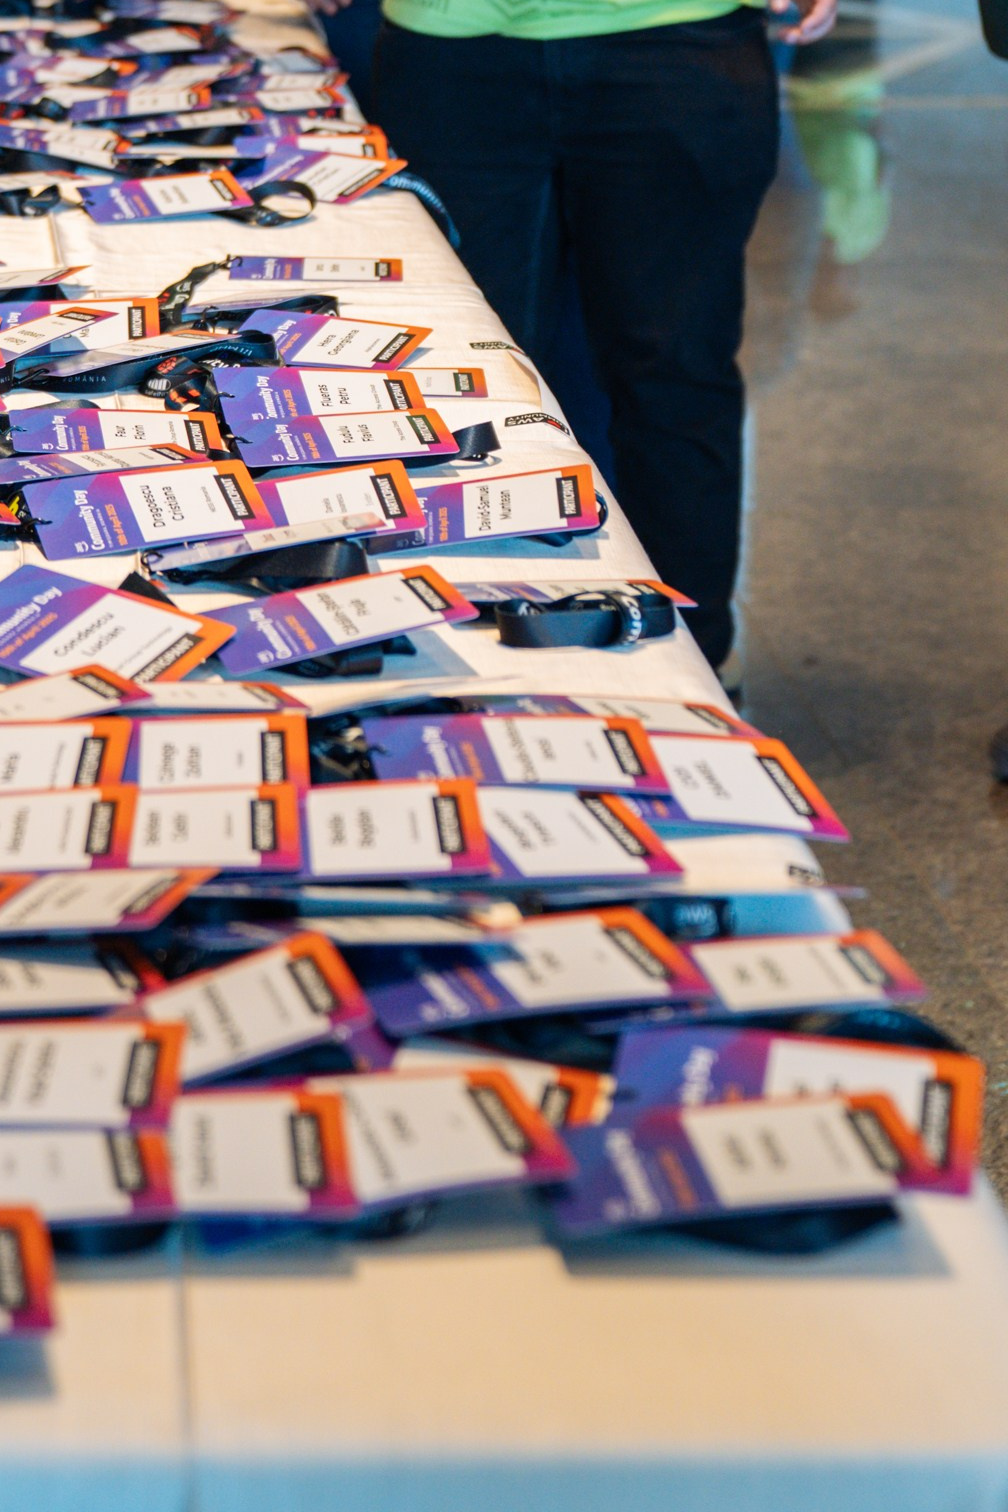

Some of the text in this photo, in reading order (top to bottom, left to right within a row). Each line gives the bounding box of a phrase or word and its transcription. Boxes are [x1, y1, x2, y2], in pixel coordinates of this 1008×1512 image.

[131, 308, 143, 337] PARTICIPANT
[318, 334, 337, 348] Hera
[328, 329, 360, 356] Georgiana
[378, 335, 409, 361] PARTICIPANT
[256, 375, 271, 388] Day
[318, 384, 333, 407] Flueras
[337, 387, 352, 405] Petru
[389, 382, 409, 410] ARTICIPANT
[52, 415, 69, 450] Community Day
[114, 425, 127, 438] Faur
[132, 424, 146, 440] Florin
[189, 422, 206, 451] PARTICIPANT
[275, 424, 300, 461] Community Day
[336, 425, 354, 444] Fudulu
[357, 423, 375, 442] Flavius
[413, 417, 435, 442] PARTICIPANT
[139, 485, 166, 528] Dragoescu
[162, 485, 185, 522] Cristiana
[221, 477, 248, 516] PARTICIPANT
[377, 477, 401, 515] PARTICIPANT
[478, 485, 491, 532] David-Samuel
[500, 489, 512, 520] Muntean
[563, 479, 577, 515] PARTICIPANT
[73, 490, 106, 550] Community Day
[33, 586, 62, 606] Day
